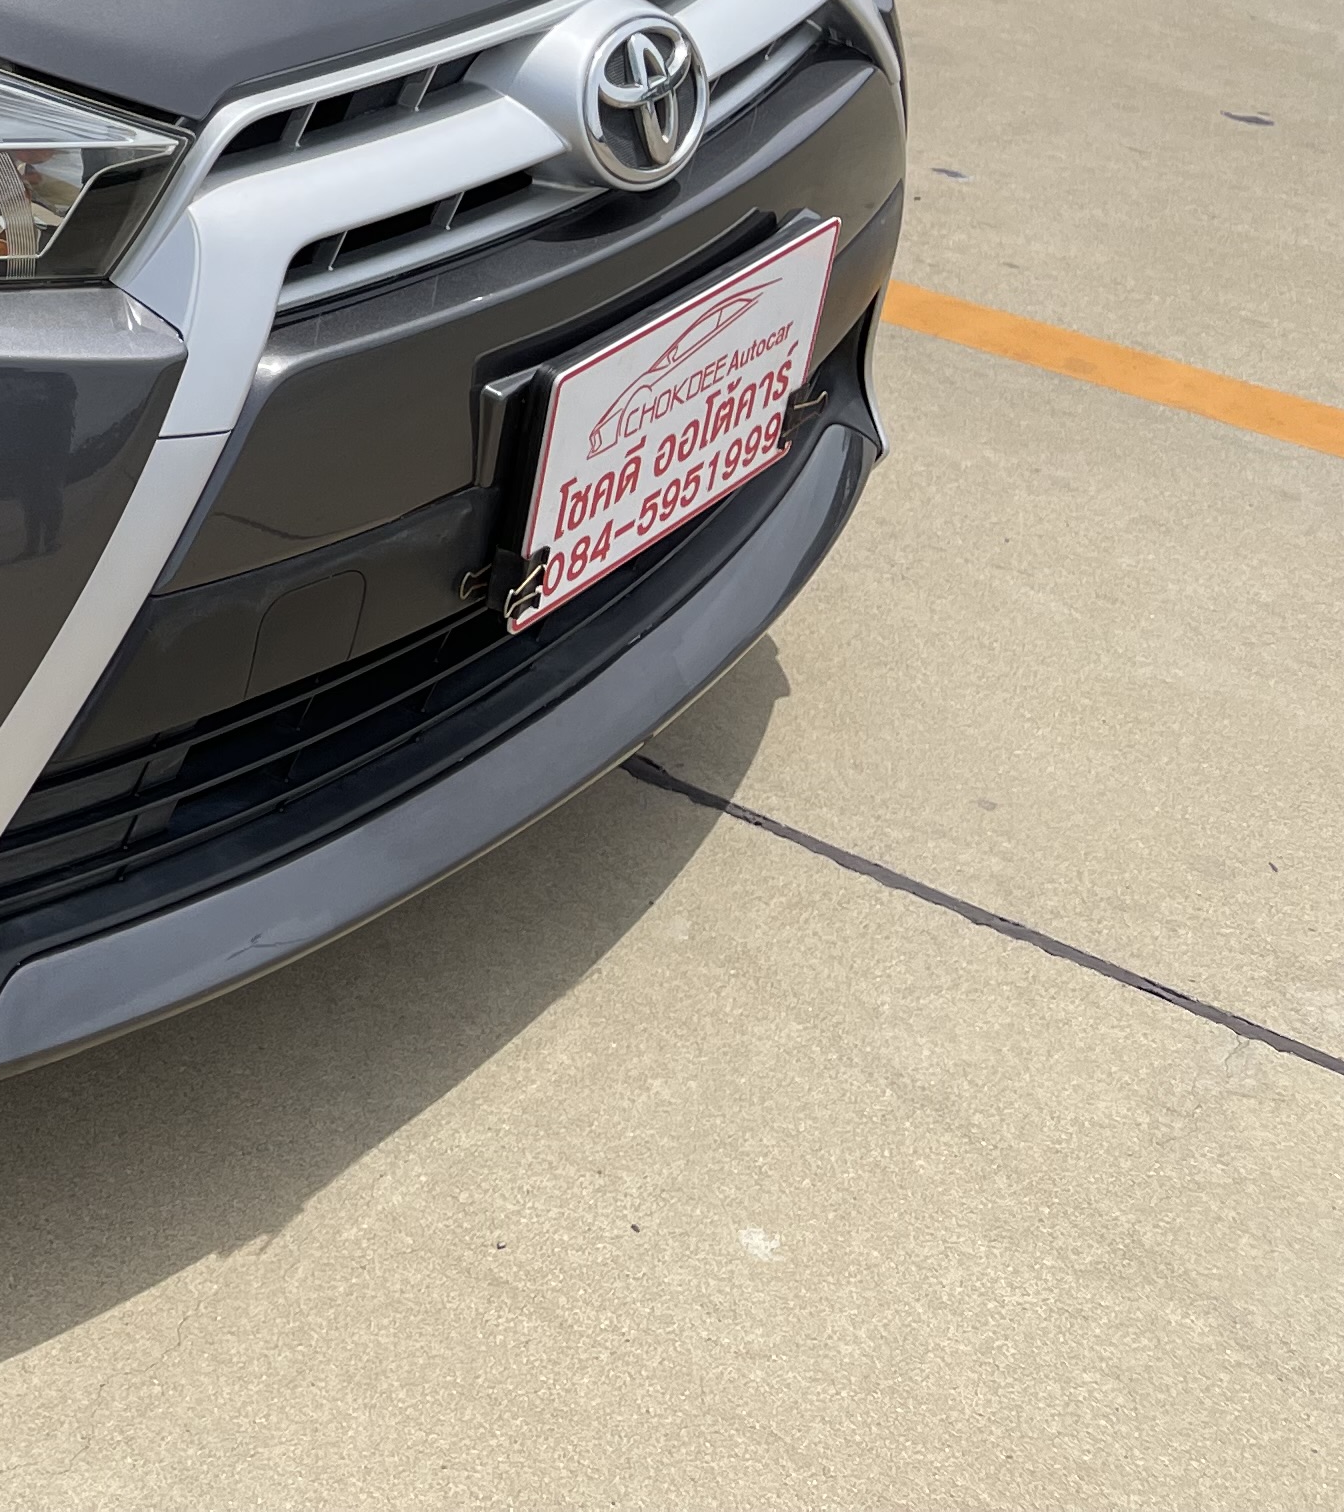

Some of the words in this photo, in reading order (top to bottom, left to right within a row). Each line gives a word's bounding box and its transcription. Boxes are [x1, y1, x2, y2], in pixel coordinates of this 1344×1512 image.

[553, 434, 648, 542] โชคดี
[652, 339, 800, 479] ออโต้คาร์
[623, 353, 729, 439] CHOKDEE
[725, 320, 795, 377] Autocar
[542, 411, 782, 597] 084-5951999
